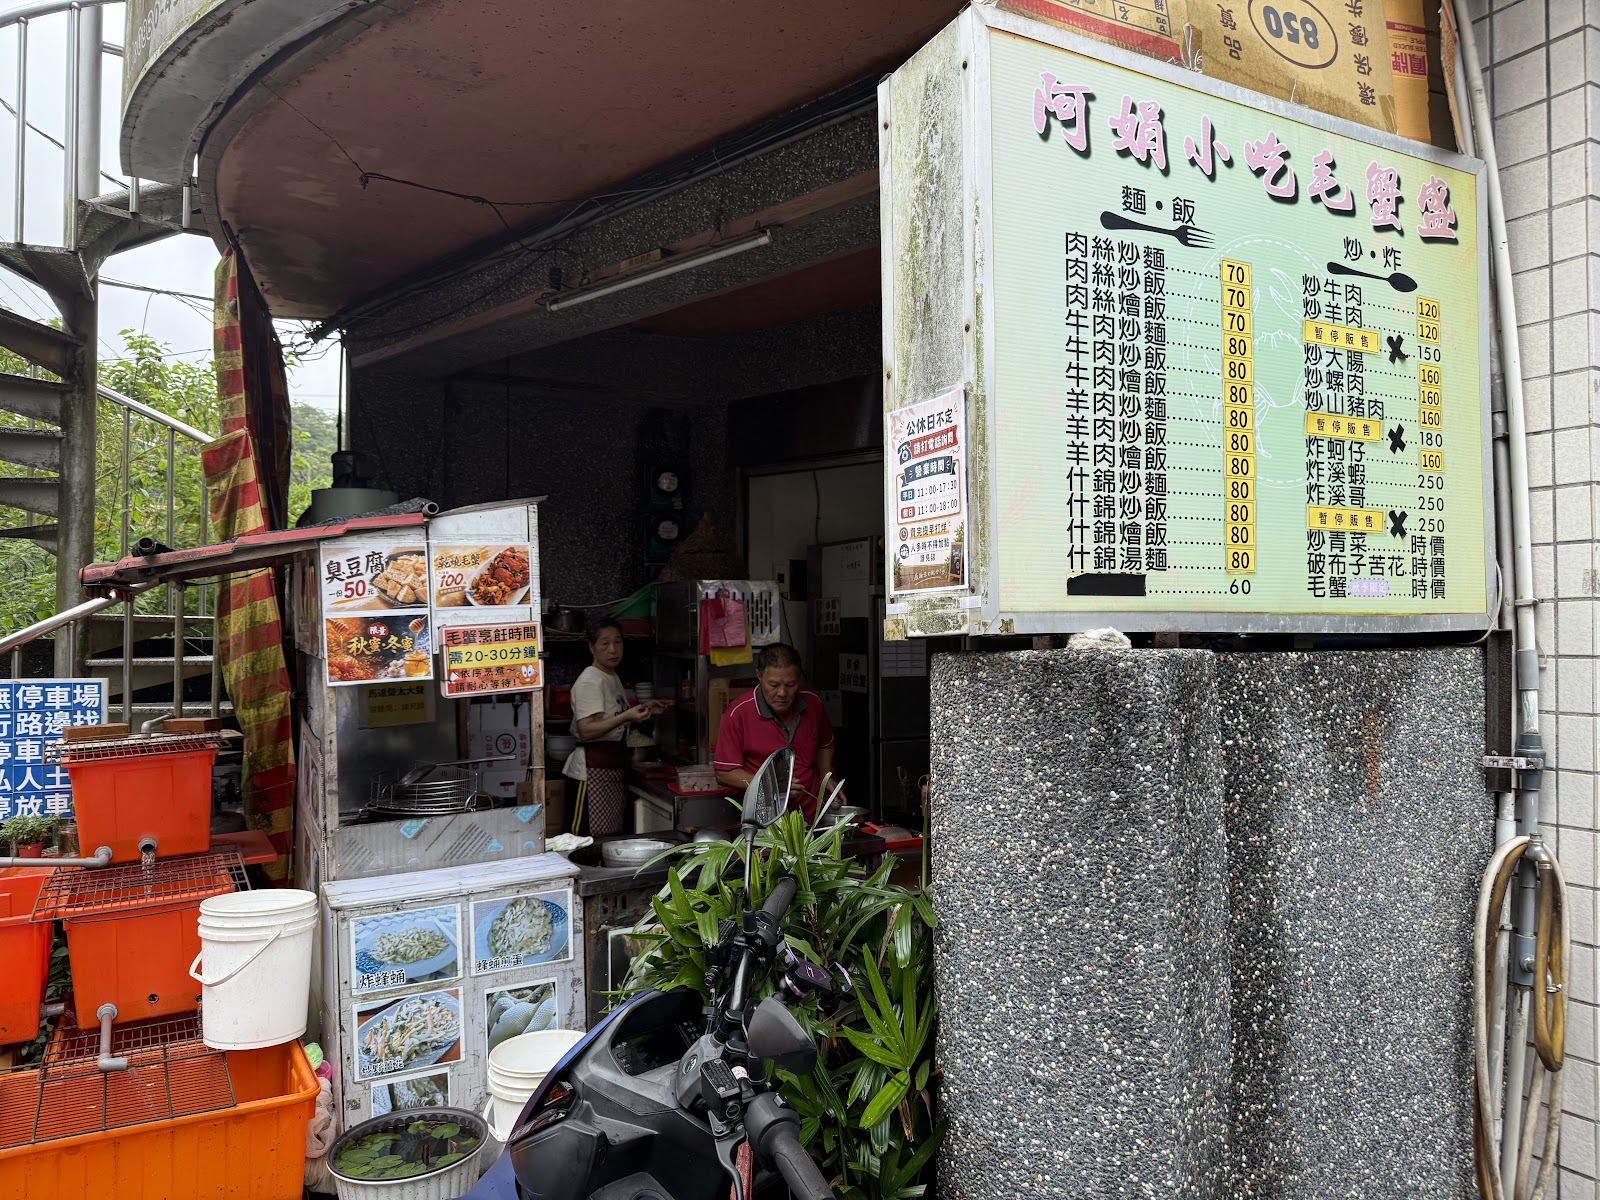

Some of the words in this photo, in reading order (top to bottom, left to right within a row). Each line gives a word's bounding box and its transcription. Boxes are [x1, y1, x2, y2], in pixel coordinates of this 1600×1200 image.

[1263, 5, 1320, 50] 850
[1033, 72, 1459, 241] 阿娟小吃毛蟹盛
[1065, 232, 1167, 271] 肉絲炒麵
[1227, 264, 1245, 284] 70
[1065, 258, 1167, 296] 肉絲炒飯
[1227, 289, 1245, 308] 70
[1302, 273, 1362, 307] 炒牛肉
[1418, 301, 1437, 319] 120
[1065, 284, 1167, 322] 肉絲燴飯
[1228, 312, 1246, 332] 70
[1303, 296, 1363, 329] 炒羊肉
[1419, 324, 1438, 341] 120
[1065, 310, 1167, 347] 牛肉炒麵
[1229, 337, 1247, 356] 80
[1314, 326, 1369, 348] 暫停販售
[1417, 345, 1441, 362] 150
[1065, 335, 1167, 371] 牛肉炒飯
[1229, 361, 1247, 380] 80
[1304, 343, 1364, 374] 炒大腸
[1421, 368, 1440, 385] 160
[1065, 361, 1167, 397] 牛肉燴飯
[1230, 385, 1248, 404] 80
[1304, 365, 1364, 396] 炒螺肉
[1421, 390, 1440, 406] 160
[906, 408, 953, 437] 公休日不定
[1065, 388, 1167, 421] 羊肉炒麵
[1230, 409, 1248, 428] 80
[1305, 388, 1384, 421] 炒山豬肉
[1421, 410, 1440, 426] 160
[913, 431, 954, 456] 請打電話詢問
[1065, 414, 1167, 446] 羊肉炒飯
[1231, 433, 1249, 452] 80
[1316, 418, 1371, 437] 暫停販售
[1419, 431, 1443, 448] 180
[914, 461, 945, 478] 營業時間
[1065, 440, 1167, 471] 羊肉燴飯
[1231, 457, 1249, 476] 80
[1422, 454, 1441, 469] 160
[1065, 466, 1167, 496] 什錦炒麵
[1231, 481, 1249, 499] 80
[1306, 459, 1366, 486] 炸溪蝦
[1417, 474, 1444, 490] 250
[902, 490, 913, 500] 平日
[1065, 492, 1167, 522] 什錦炒飯
[1231, 504, 1249, 522] 80
[1306, 481, 1366, 509] 炸溪哥
[1418, 496, 1444, 511] 250
[1065, 518, 1167, 546] 什錦燴飯
[1231, 526, 1249, 544] 80
[1318, 512, 1373, 528] 暫停販售
[1418, 518, 1445, 533] 250
[1065, 544, 1167, 571] 什錦湯麵
[1232, 551, 1250, 569] 80
[1307, 529, 1367, 553] 炒青菜
[1411, 535, 1445, 557] 時價
[325, 550, 386, 584] 臭豆腐
[440, 573, 464, 587] 100
[1307, 552, 1405, 577] 破布子苦花
[1412, 557, 1446, 578] 時價
[343, 579, 367, 599] 50
[1229, 578, 1251, 595] 60
[1307, 575, 1347, 599] 毛蟹
[1412, 578, 1446, 599] 時價
[449, 646, 537, 665] 需20-30分鐘
[359, 969, 406, 989] 炸蜂蛹
